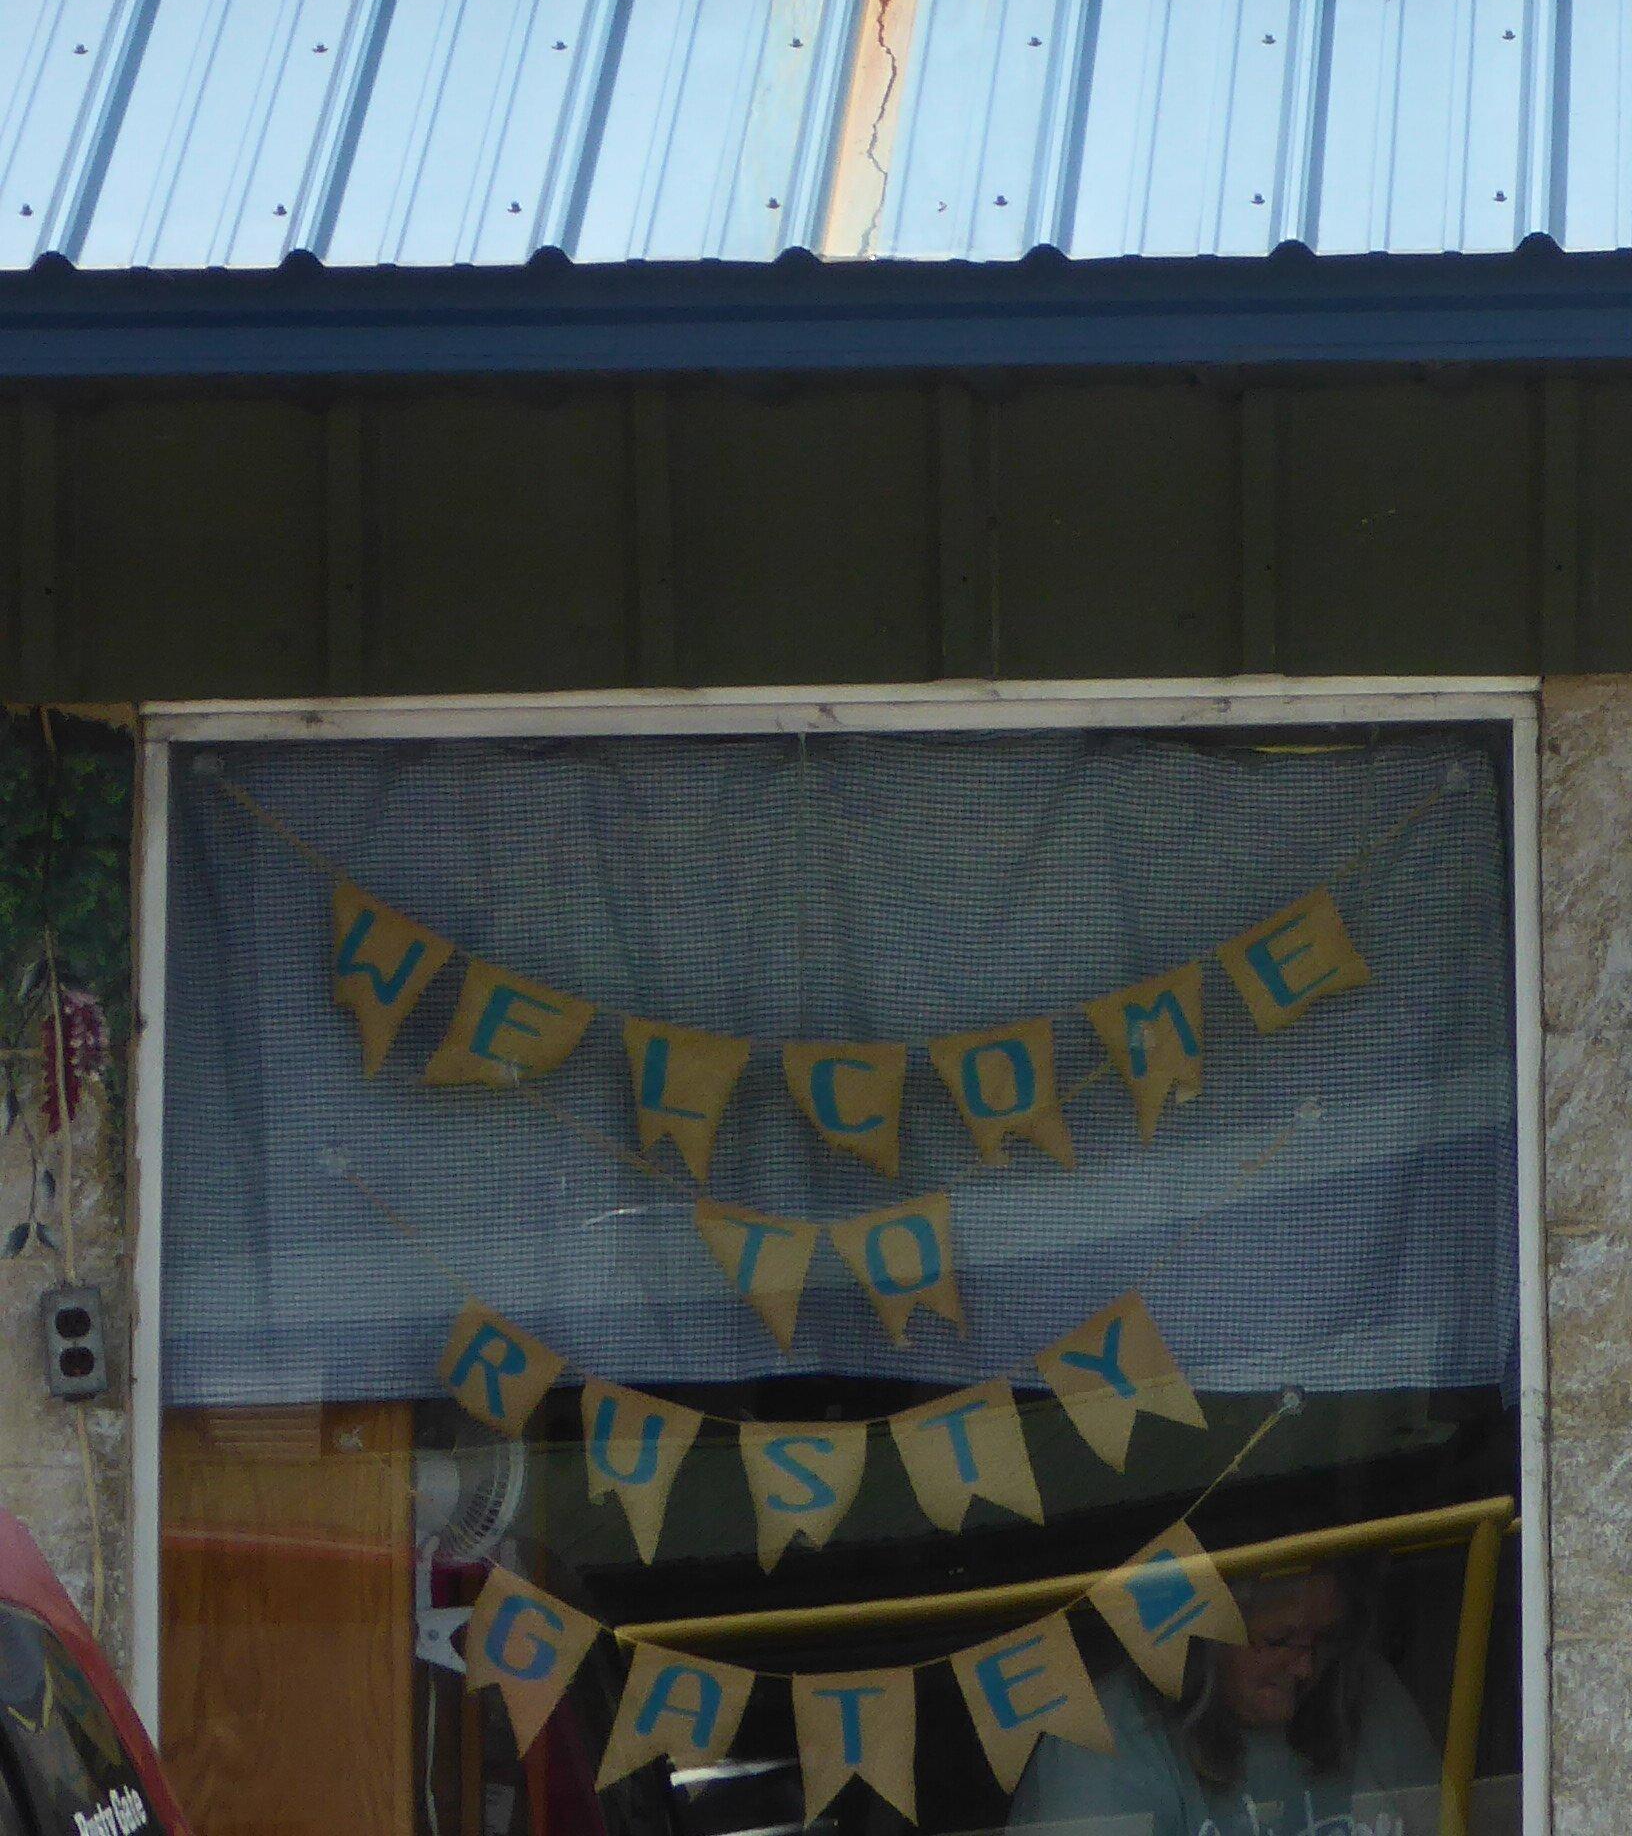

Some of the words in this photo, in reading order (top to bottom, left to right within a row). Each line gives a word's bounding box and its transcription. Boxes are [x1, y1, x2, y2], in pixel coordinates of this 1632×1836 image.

[338, 910, 1340, 1134] WELCOME
[722, 1215, 942, 1296] TO
[449, 1318, 1138, 1514] RUSTY
[484, 1595, 1070, 1765] GATE
